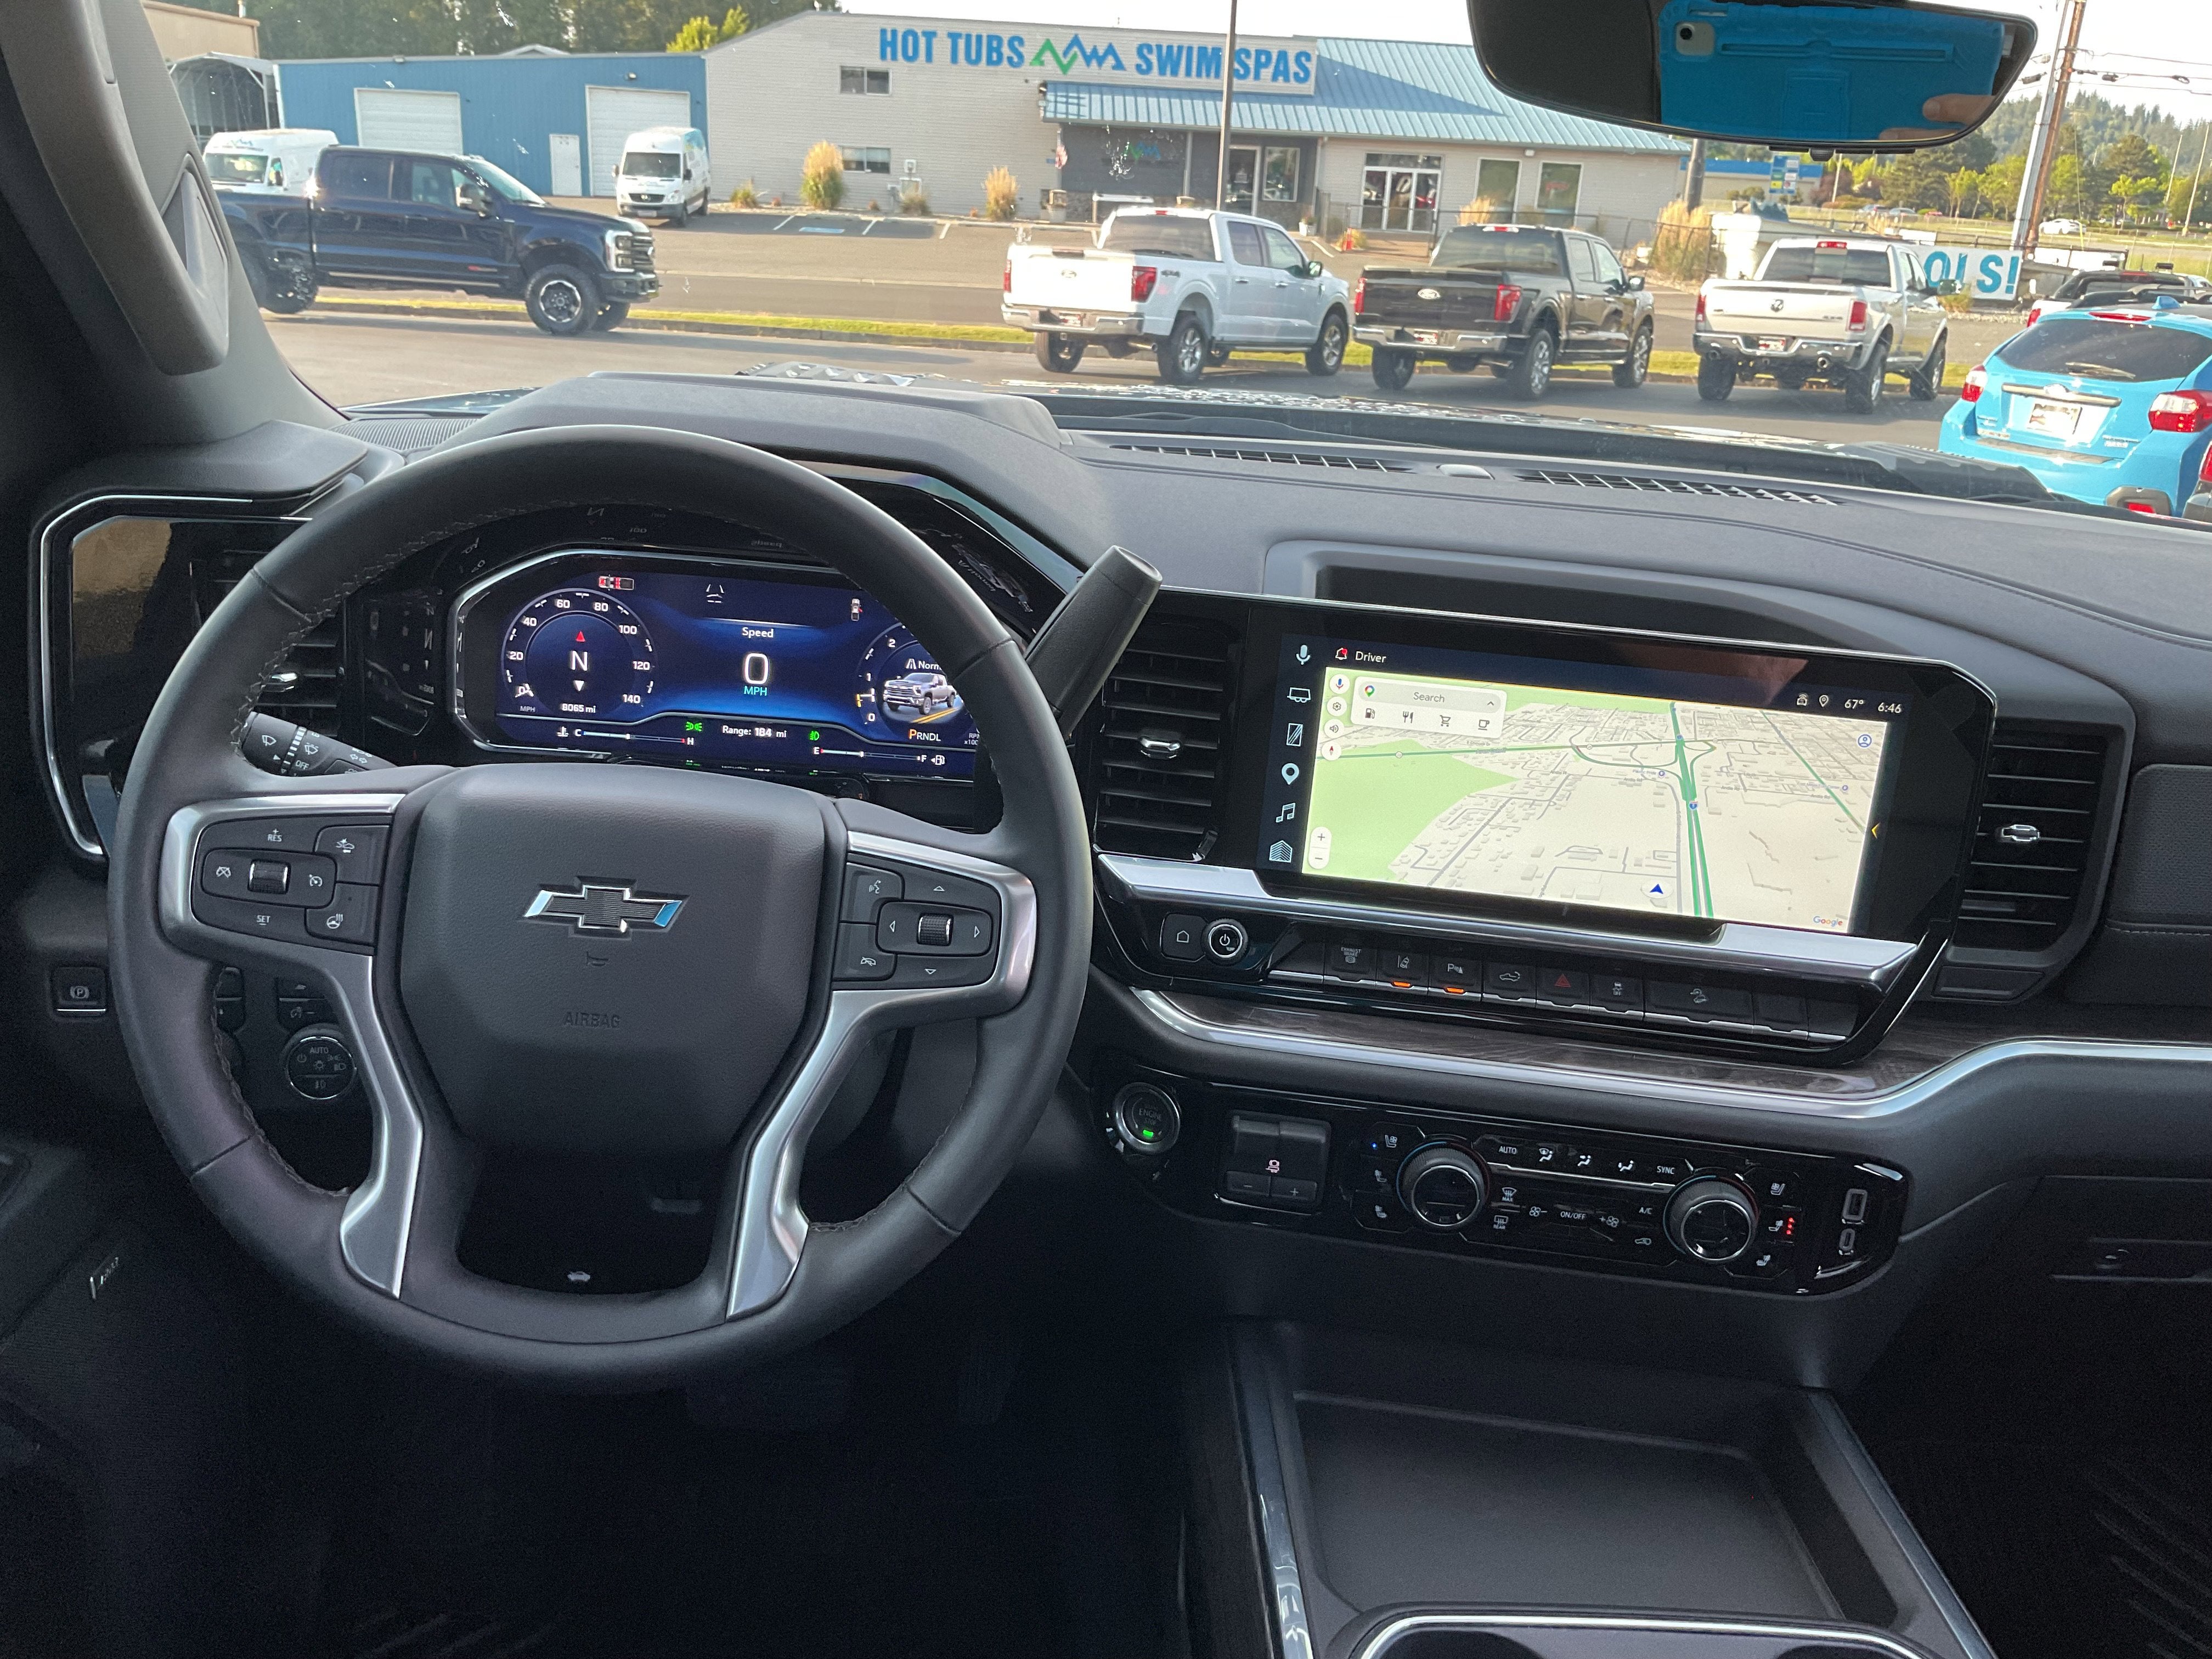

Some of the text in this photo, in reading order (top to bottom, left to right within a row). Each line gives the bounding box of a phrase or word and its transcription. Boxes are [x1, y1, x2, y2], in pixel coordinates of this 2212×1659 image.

[879, 29, 1312, 84] HOT TUBS SWIM SPAS
[556, 599, 571, 609] 60
[594, 602, 608, 612] 80
[523, 617, 537, 627] 40
[619, 625, 637, 635] 100
[742, 627, 774, 640] Speed
[888, 638, 896, 648] 2
[510, 651, 524, 661] 20
[571, 651, 589, 671] N
[1355, 651, 1386, 663] Driver
[633, 661, 651, 670] 120
[744, 652, 769, 685] 0
[866, 673, 872, 681] 1
[743, 685, 768, 696] MPH
[623, 694, 641, 704] 140
[1413, 691, 1446, 703] Search
[1877, 702, 1902, 714] 6:46
[868, 713, 876, 722] 0
[574, 729, 582, 737] C
[722, 725, 787, 739] Range: 184 mi
[687, 737, 695, 746] H
[813, 747, 820, 755] E
[921, 754, 927, 763] F
[295, 760, 309, 770] OFF
[268, 834, 282, 842] RES
[257, 915, 271, 924] SET
[1813, 916, 1843, 927] Google
[562, 1012, 620, 1028] AIRBAG
[309, 1046, 329, 1054] AUTO
[1498, 1146, 1517, 1155] AUTO
[1656, 1165, 1675, 1175] SYNC
[1560, 1211, 1587, 1220] ON/OFF
[1638, 1206, 1652, 1215] A/C
